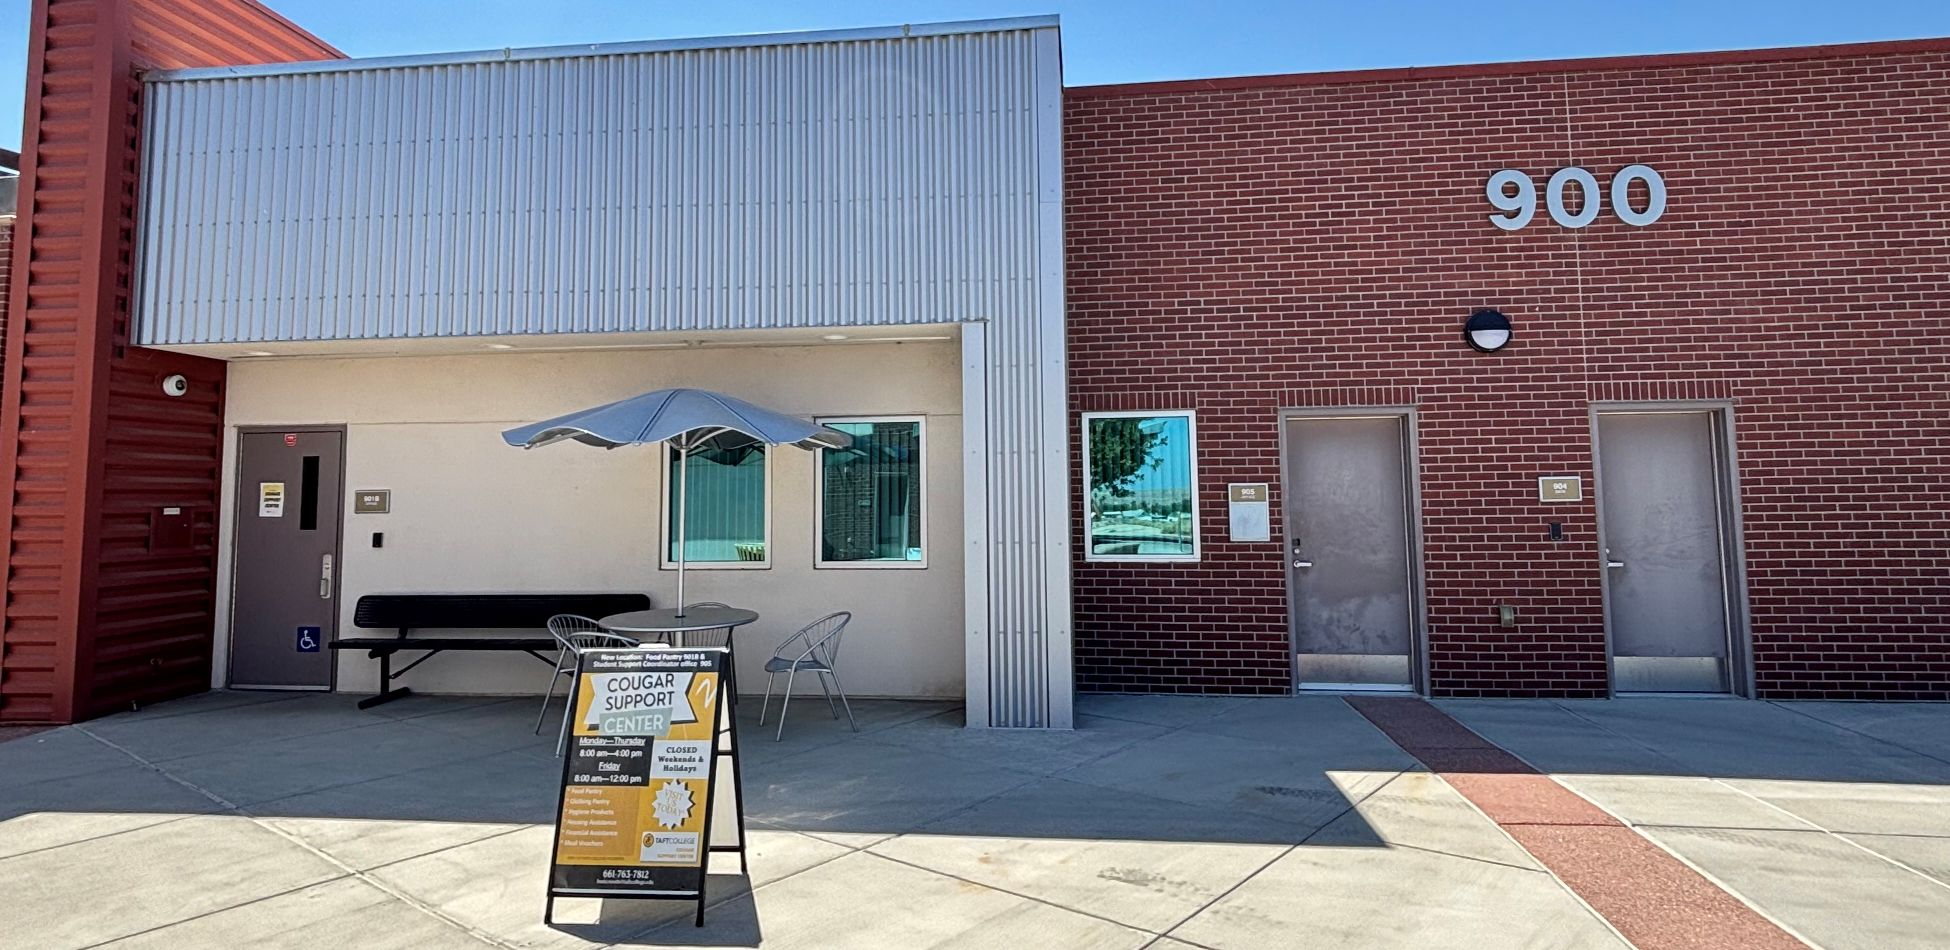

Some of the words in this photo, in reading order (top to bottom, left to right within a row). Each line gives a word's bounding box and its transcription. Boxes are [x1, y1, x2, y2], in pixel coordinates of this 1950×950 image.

[1486, 164, 1667, 231] 900
[1553, 482, 1567, 490] 904
[600, 653, 614, 661] New
[616, 653, 643, 661] Location:
[645, 653, 660, 661] Food
[662, 653, 683, 662] Pantry
[593, 660, 618, 668] Student
[618, 660, 642, 669] Support
[643, 660, 680, 668] Coordinator
[607, 673, 675, 693] COUGAR
[605, 691, 676, 711] SUPPORT
[604, 714, 664, 733] CENTER
[579, 749, 596, 757] 8:00
[630, 750, 643, 758] pm
[666, 746, 698, 754] CLOSED
[657, 755, 696, 763] Weekends
[698, 755, 704, 763] &
[598, 761, 621, 771] Friday
[663, 764, 697, 774] Holidays
[574, 774, 590, 783] 8:00
[629, 775, 642, 784] pm
[665, 788, 684, 801] VISIT
[602, 869, 650, 879] 661-763-7812
